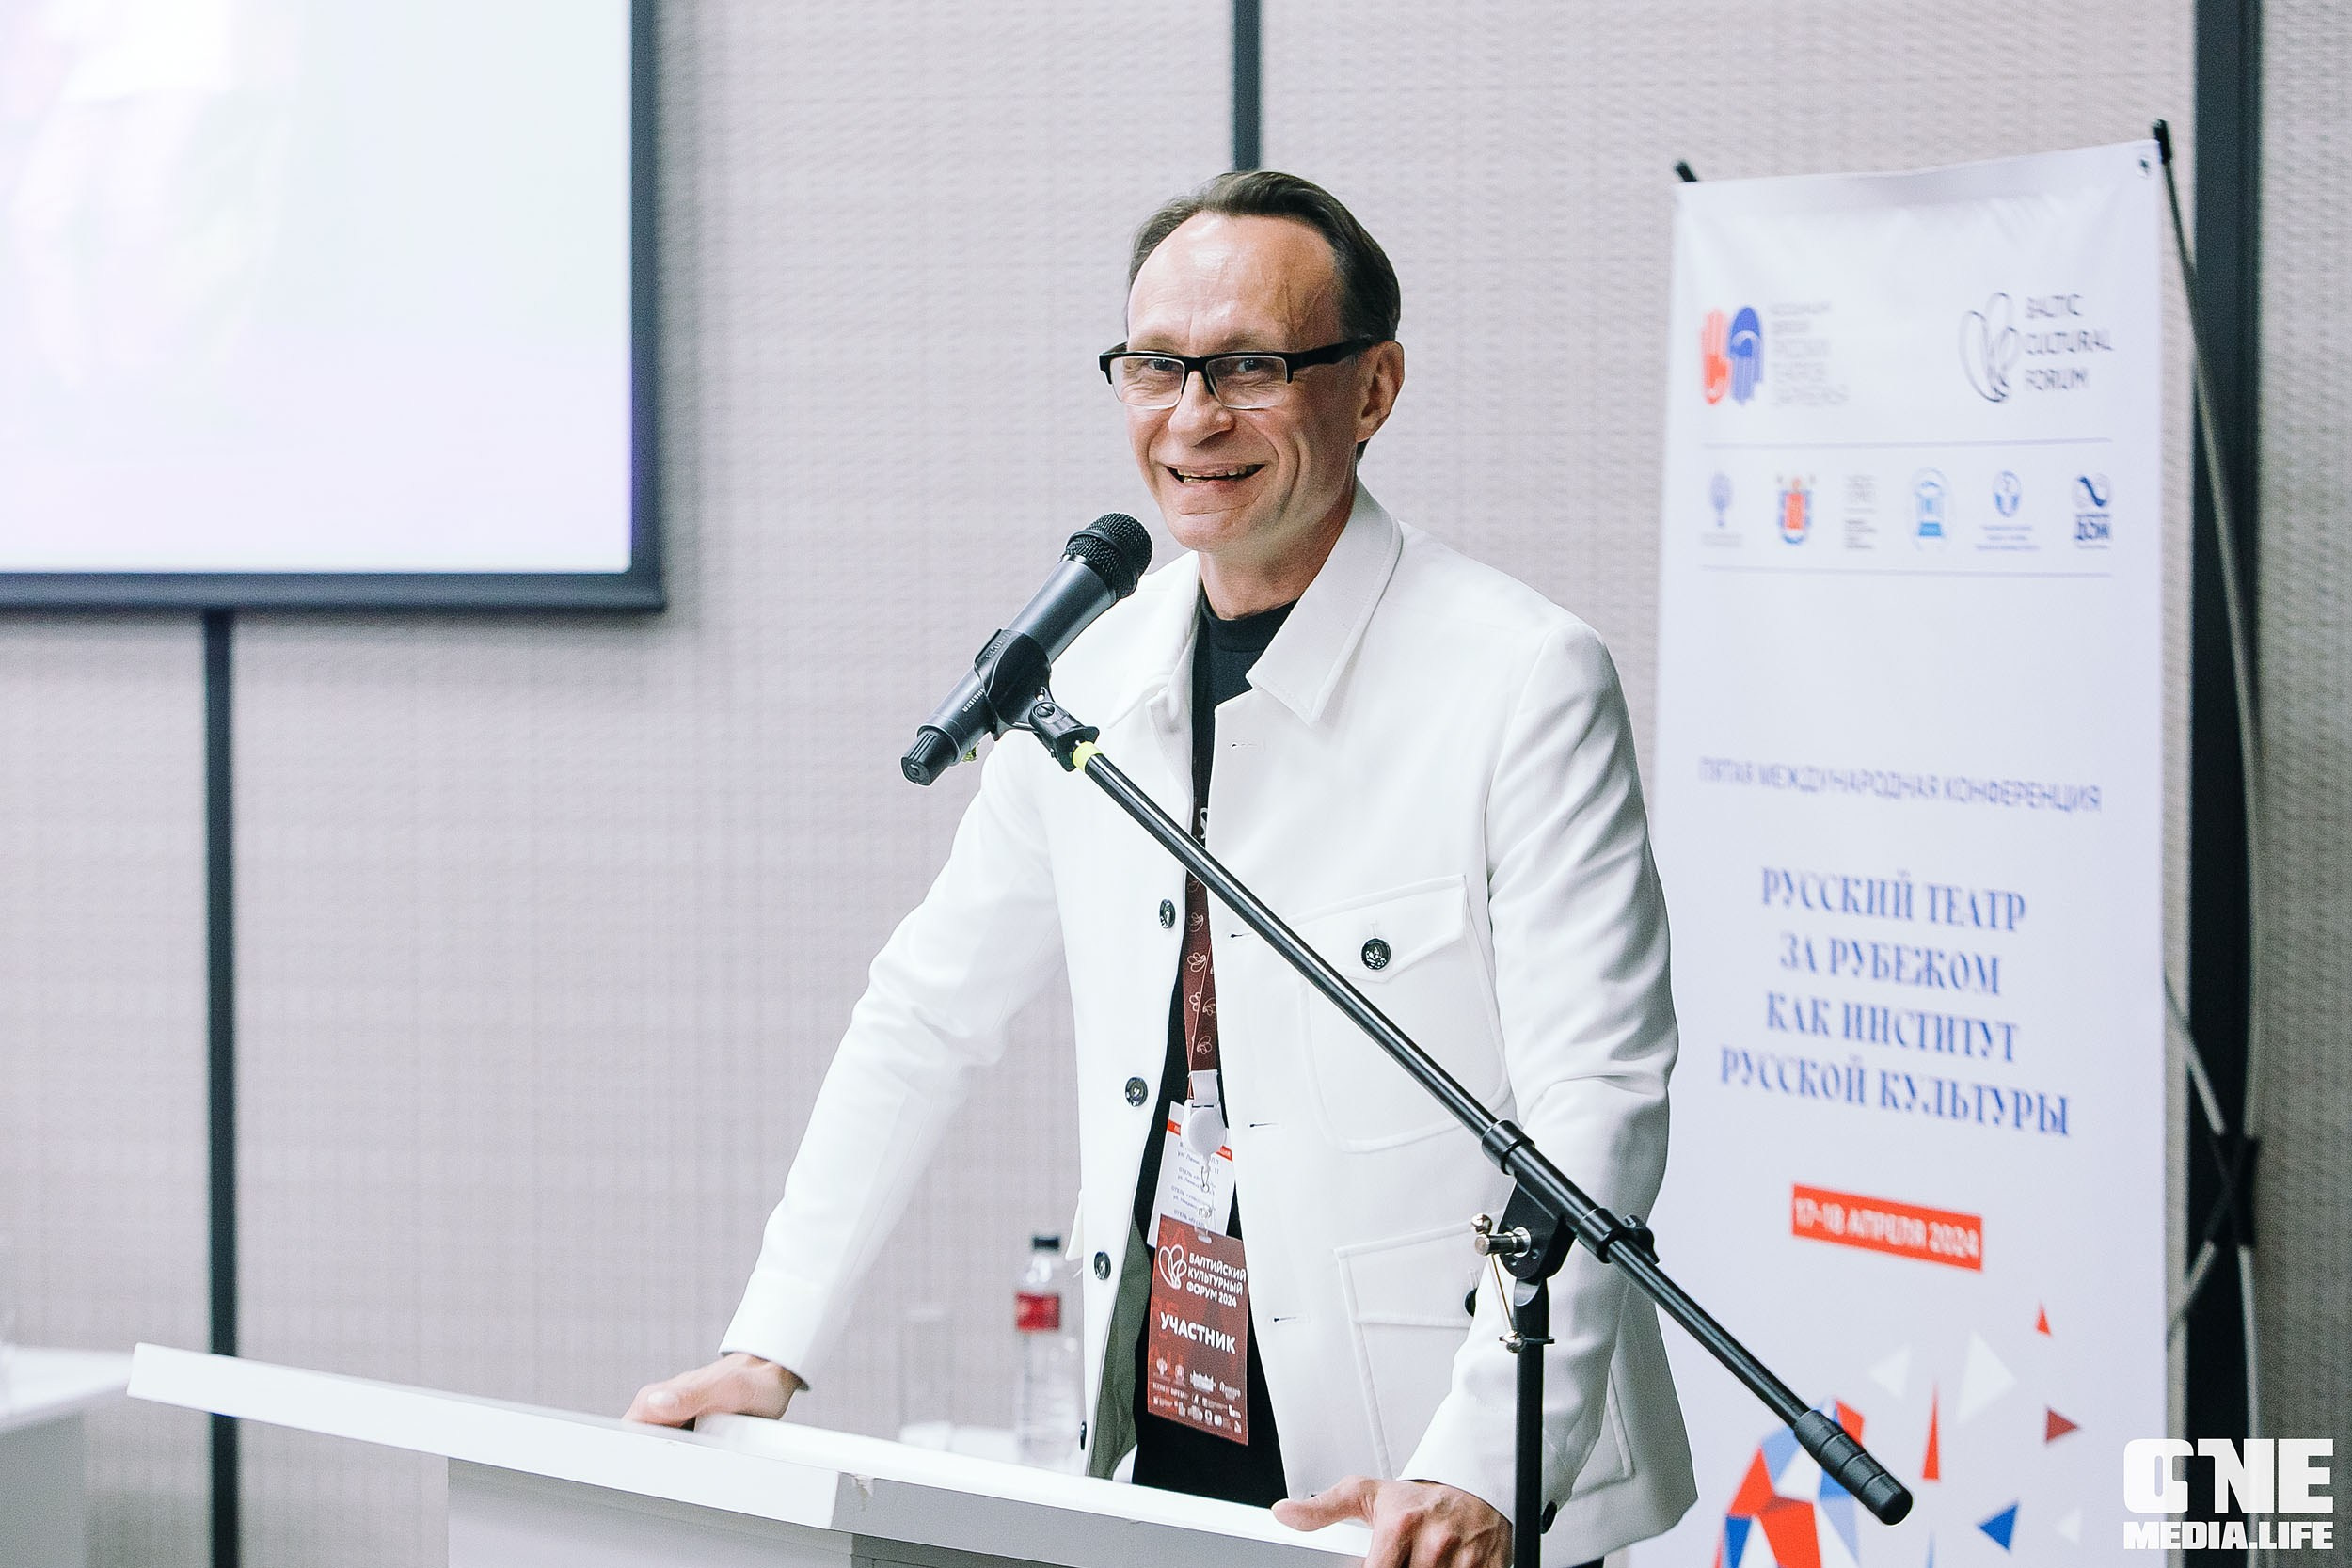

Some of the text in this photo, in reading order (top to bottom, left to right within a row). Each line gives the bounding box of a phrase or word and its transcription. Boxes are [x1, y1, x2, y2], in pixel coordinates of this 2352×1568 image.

[2026, 293, 2083, 318] BALTIC
[2026, 329, 2113, 355] CULTURAL
[2026, 368, 2089, 390] FORUM
[1762, 867, 2026, 932] РУССКИЙ ТЕАТР
[1781, 933, 2000, 996] ЗА РУБЕЖОМ
[1767, 990, 2018, 1063] КАК ИНСТИТУТ
[1721, 1046, 2069, 1137] РУССКОЙ КУЛЬТУРЫ
[1794, 1198, 1979, 1258] 17-18 АПРЕЛЯ 2024
[1187, 1266, 1243, 1295] КУЛЬТУРНЫЙ
[1188, 1252, 1247, 1282] БАЛТИЙСКИЙ
[1186, 1280, 1237, 1308] ФОРУМ 2024
[1160, 1311, 1236, 1354] УЧАСТНИК
